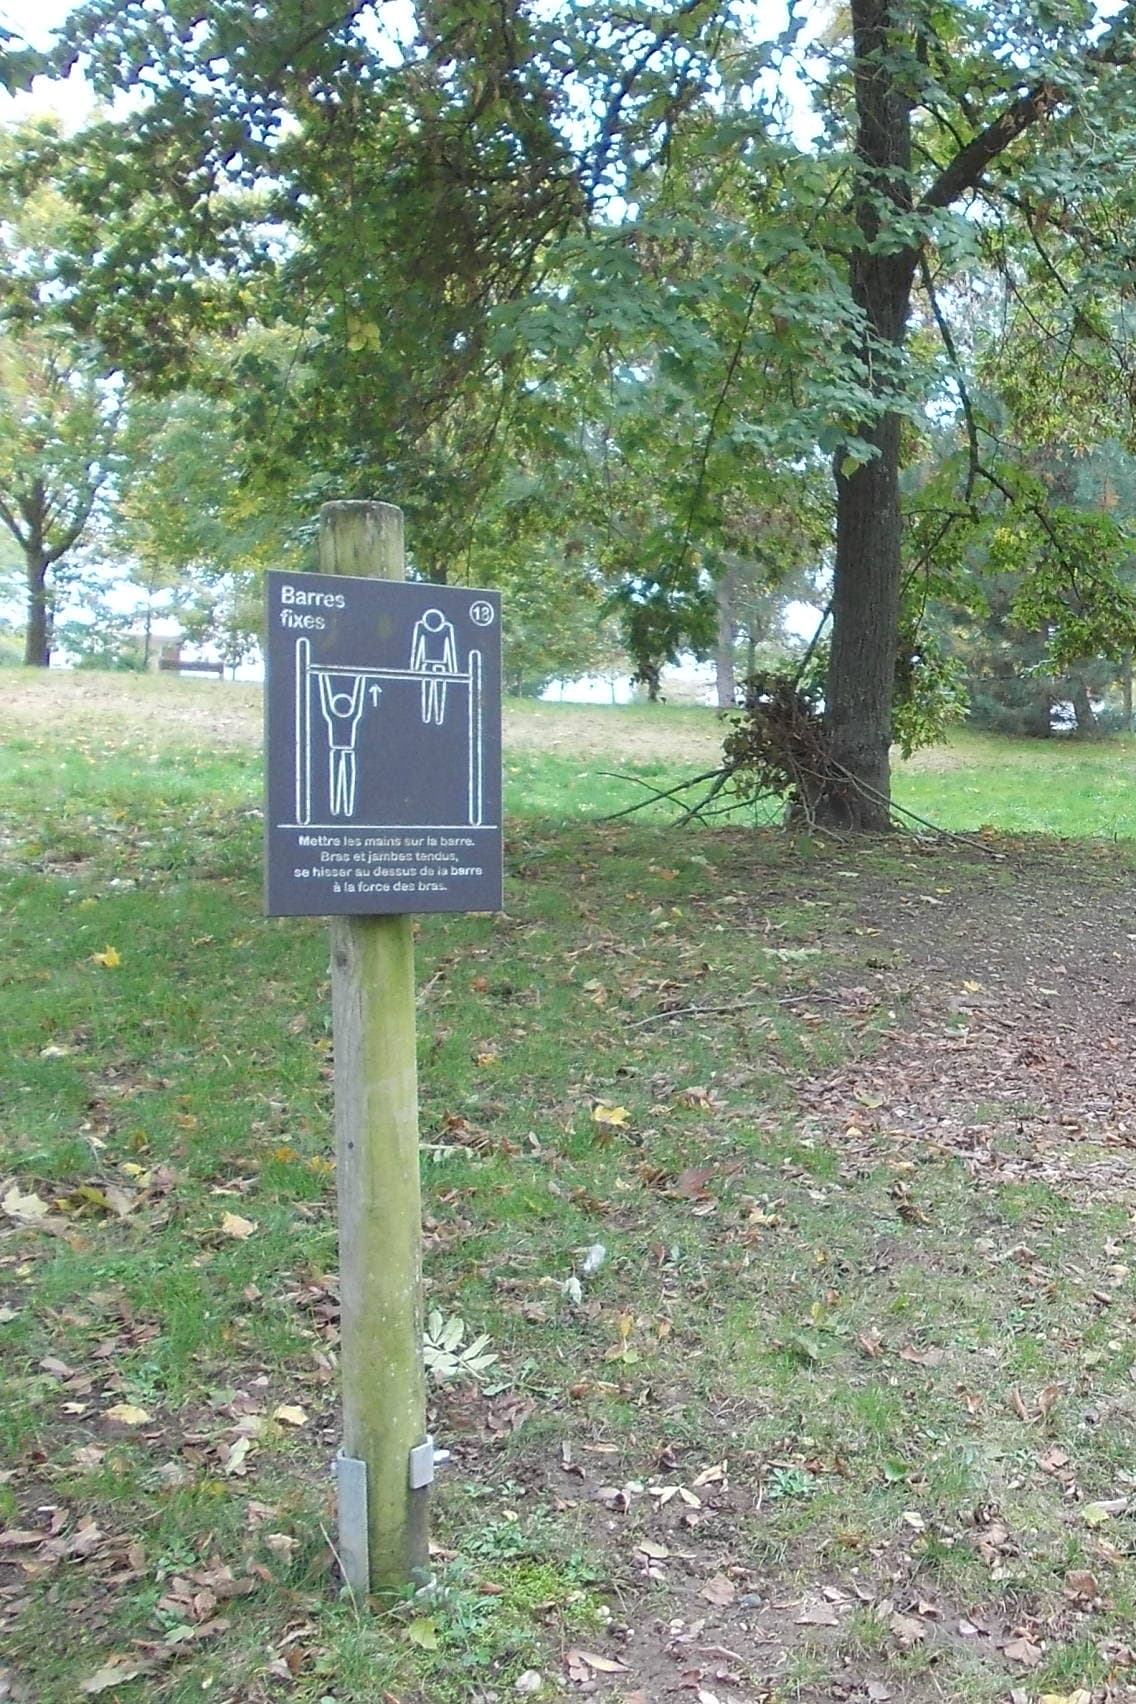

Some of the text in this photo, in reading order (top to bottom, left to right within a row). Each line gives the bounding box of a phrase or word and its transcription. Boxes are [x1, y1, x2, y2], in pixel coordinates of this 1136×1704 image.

[281, 586, 346, 608] Barres
[280, 609, 325, 630] fixes
[298, 836, 475, 846] Mettre les mains sur la barre.
[321, 851, 459, 863] Bras et jambes tendus,
[294, 866, 483, 878] se hisser au dessus de la barre
[333, 881, 448, 893] à la force des bras.
